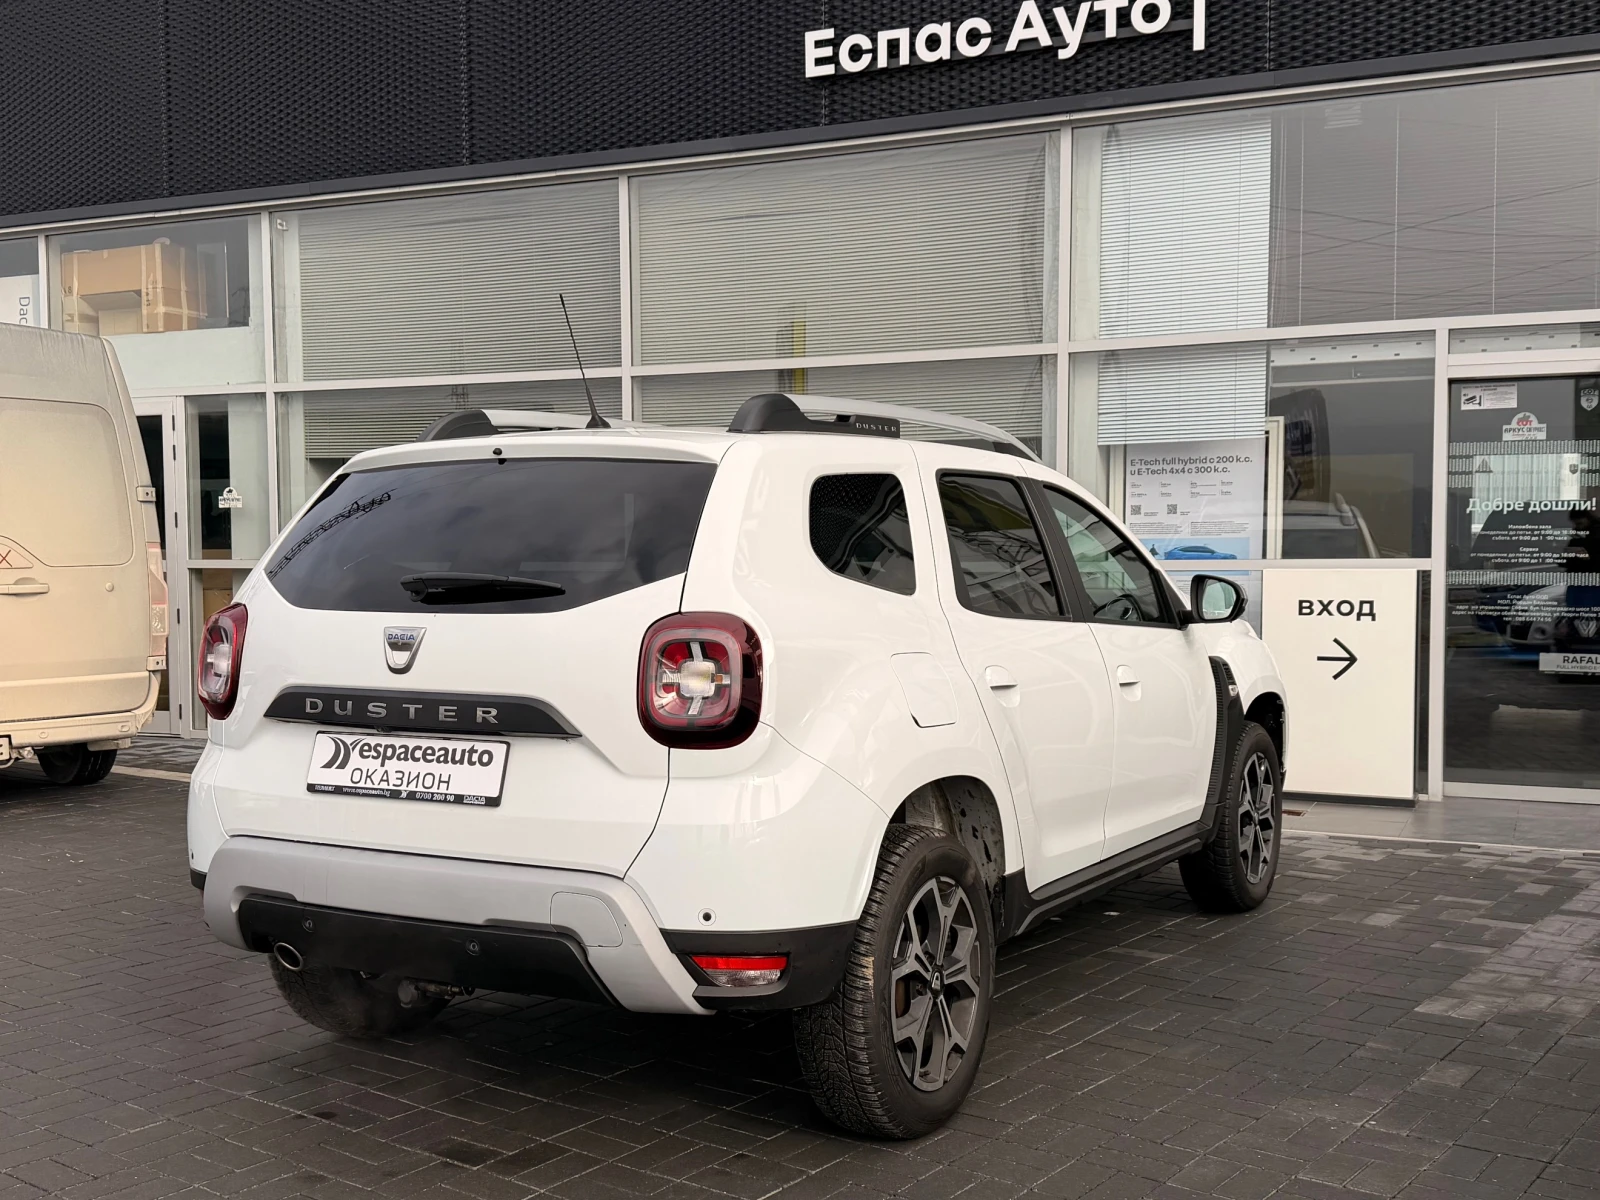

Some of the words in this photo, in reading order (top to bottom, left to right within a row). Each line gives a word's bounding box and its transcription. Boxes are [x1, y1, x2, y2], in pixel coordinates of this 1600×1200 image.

[804, 17, 993, 78] Еспас
[1005, 0, 1172, 60] Ауто
[855, 421, 898, 433] DUSTER
[1130, 458, 1160, 467] E-Tech
[1162, 457, 1177, 465] full
[1178, 456, 1207, 466] hybrid
[1216, 456, 1234, 464] 200
[1137, 466, 1168, 475] E-Tech
[1194, 466, 1212, 474] 300
[1466, 498, 1524, 514] Добре
[1528, 498, 1596, 513] дошли!
[387, 633, 415, 642] DACIA
[305, 698, 498, 724] DUSTER
[358, 742, 494, 767] espaceauto
[350, 768, 451, 791] ОКАЗИОН
[416, 791, 432, 800] 0700
[433, 793, 445, 801] 200
[446, 794, 455, 802] 90
